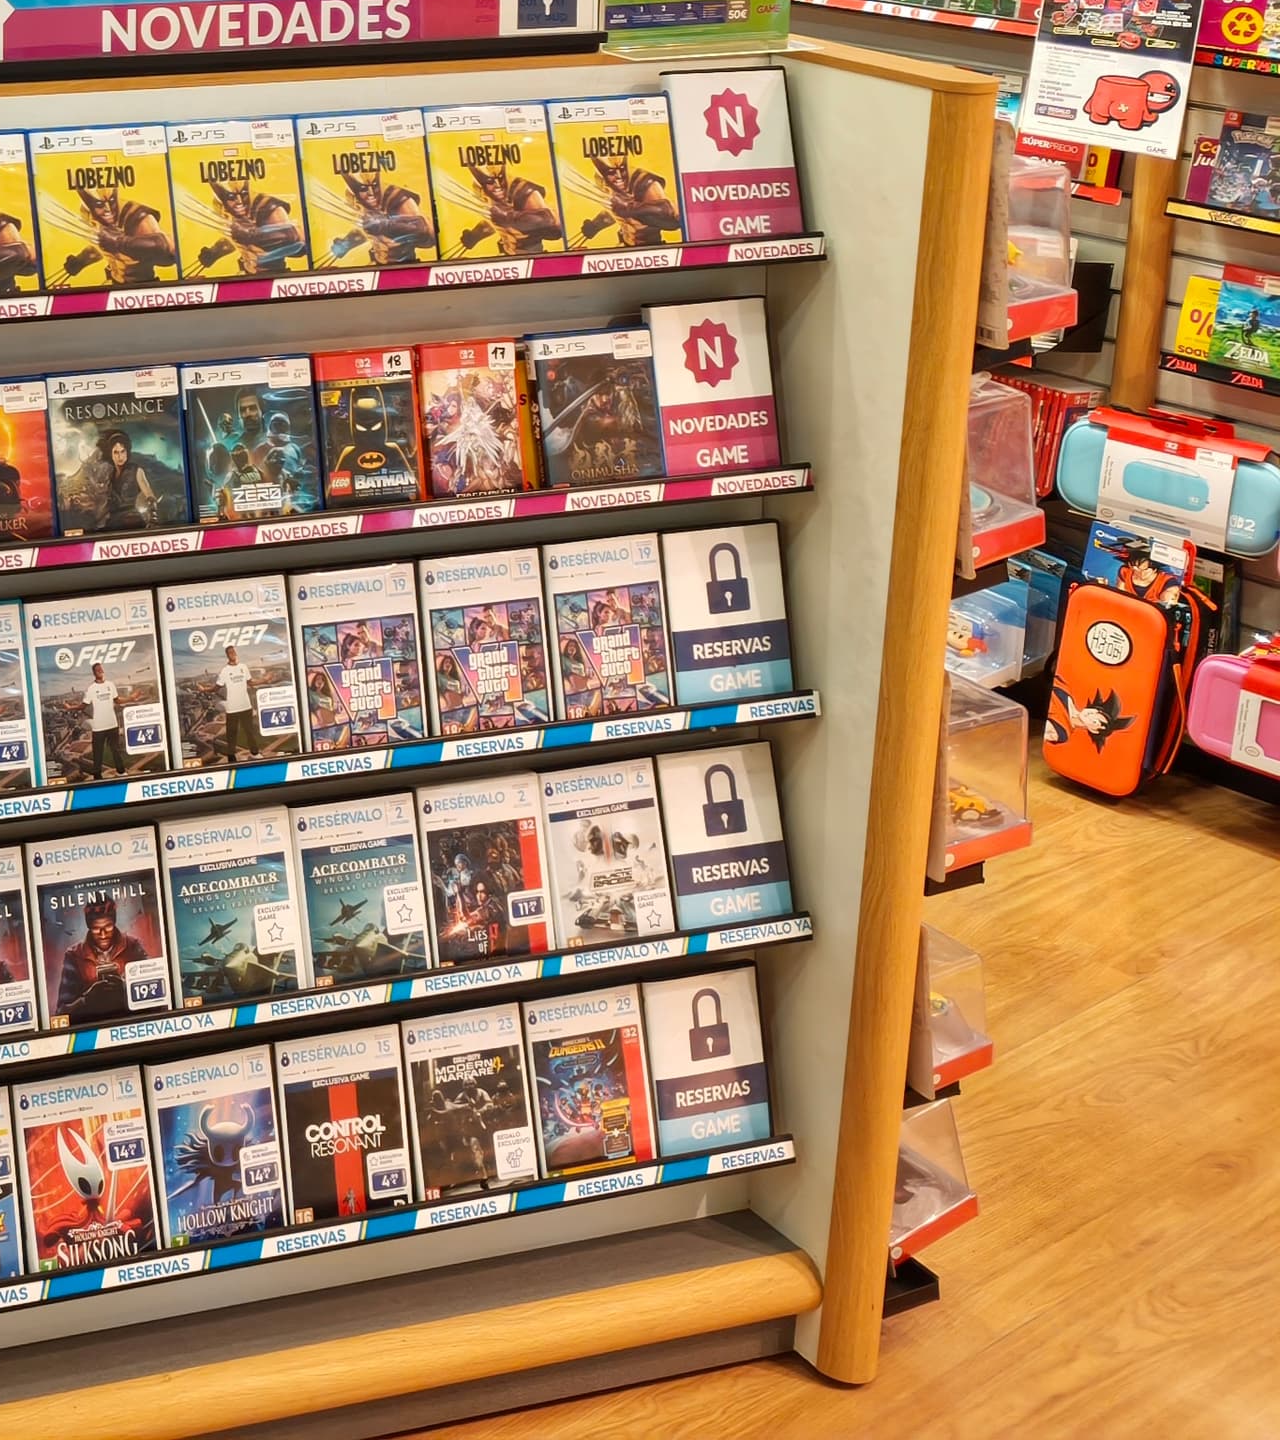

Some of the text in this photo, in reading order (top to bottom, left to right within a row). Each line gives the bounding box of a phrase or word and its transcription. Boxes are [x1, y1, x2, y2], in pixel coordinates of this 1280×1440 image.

[728, 9, 748, 19] 50€
[574, 106, 606, 118] PS5
[691, 182, 791, 205] NOVEDADES
[733, 242, 815, 260] NOVEDADES
[64, 398, 165, 421] RESONANCE
[354, 472, 416, 489] BATMAN
[570, 462, 640, 480] ONIMUSHA
[592, 631, 632, 651] grand
[601, 646, 640, 663] theft
[601, 660, 632, 676] auto
[423, 966, 523, 992] RESERVALO YA
[434, 1058, 493, 1078] MODERN
[434, 1067, 494, 1084] WARFARE
[31, 1079, 134, 1108] RESÉRVALO 16
[305, 1113, 386, 1143] CONTROL
[310, 1132, 383, 1159] RESONANT
[721, 1145, 786, 1170] RESERVAS
[56, 1230, 139, 1269] SILKSONG
